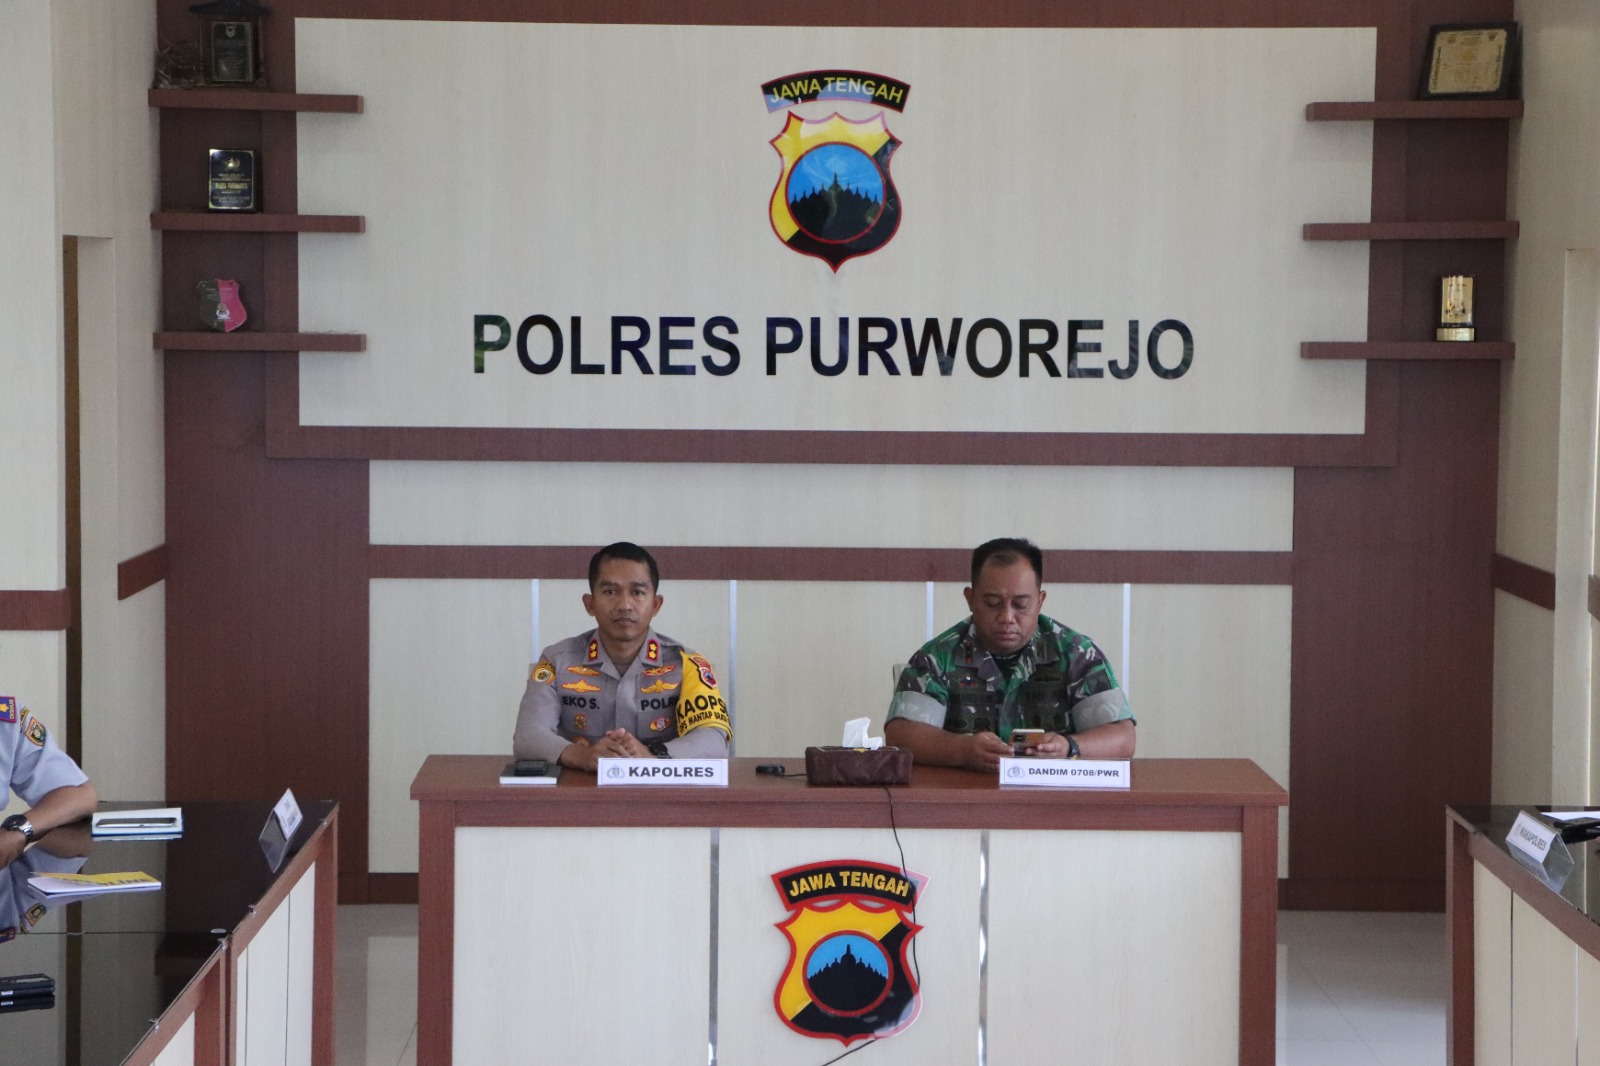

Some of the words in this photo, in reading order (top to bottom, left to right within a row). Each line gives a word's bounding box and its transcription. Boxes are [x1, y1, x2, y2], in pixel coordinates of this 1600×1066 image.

[771, 78, 822, 103] JAWA
[824, 77, 903, 103] TENGAH
[473, 314, 741, 376] POLRES
[765, 316, 1195, 380] PURWOREJO
[562, 696, 587, 708] EKO
[589, 698, 600, 710] S.
[628, 766, 714, 778] KAPOLRES
[1028, 767, 1068, 776] DANDIM
[1071, 768, 1119, 778] 0708/PWR
[789, 873, 836, 897] JAWA
[839, 871, 909, 897] TENGAH
